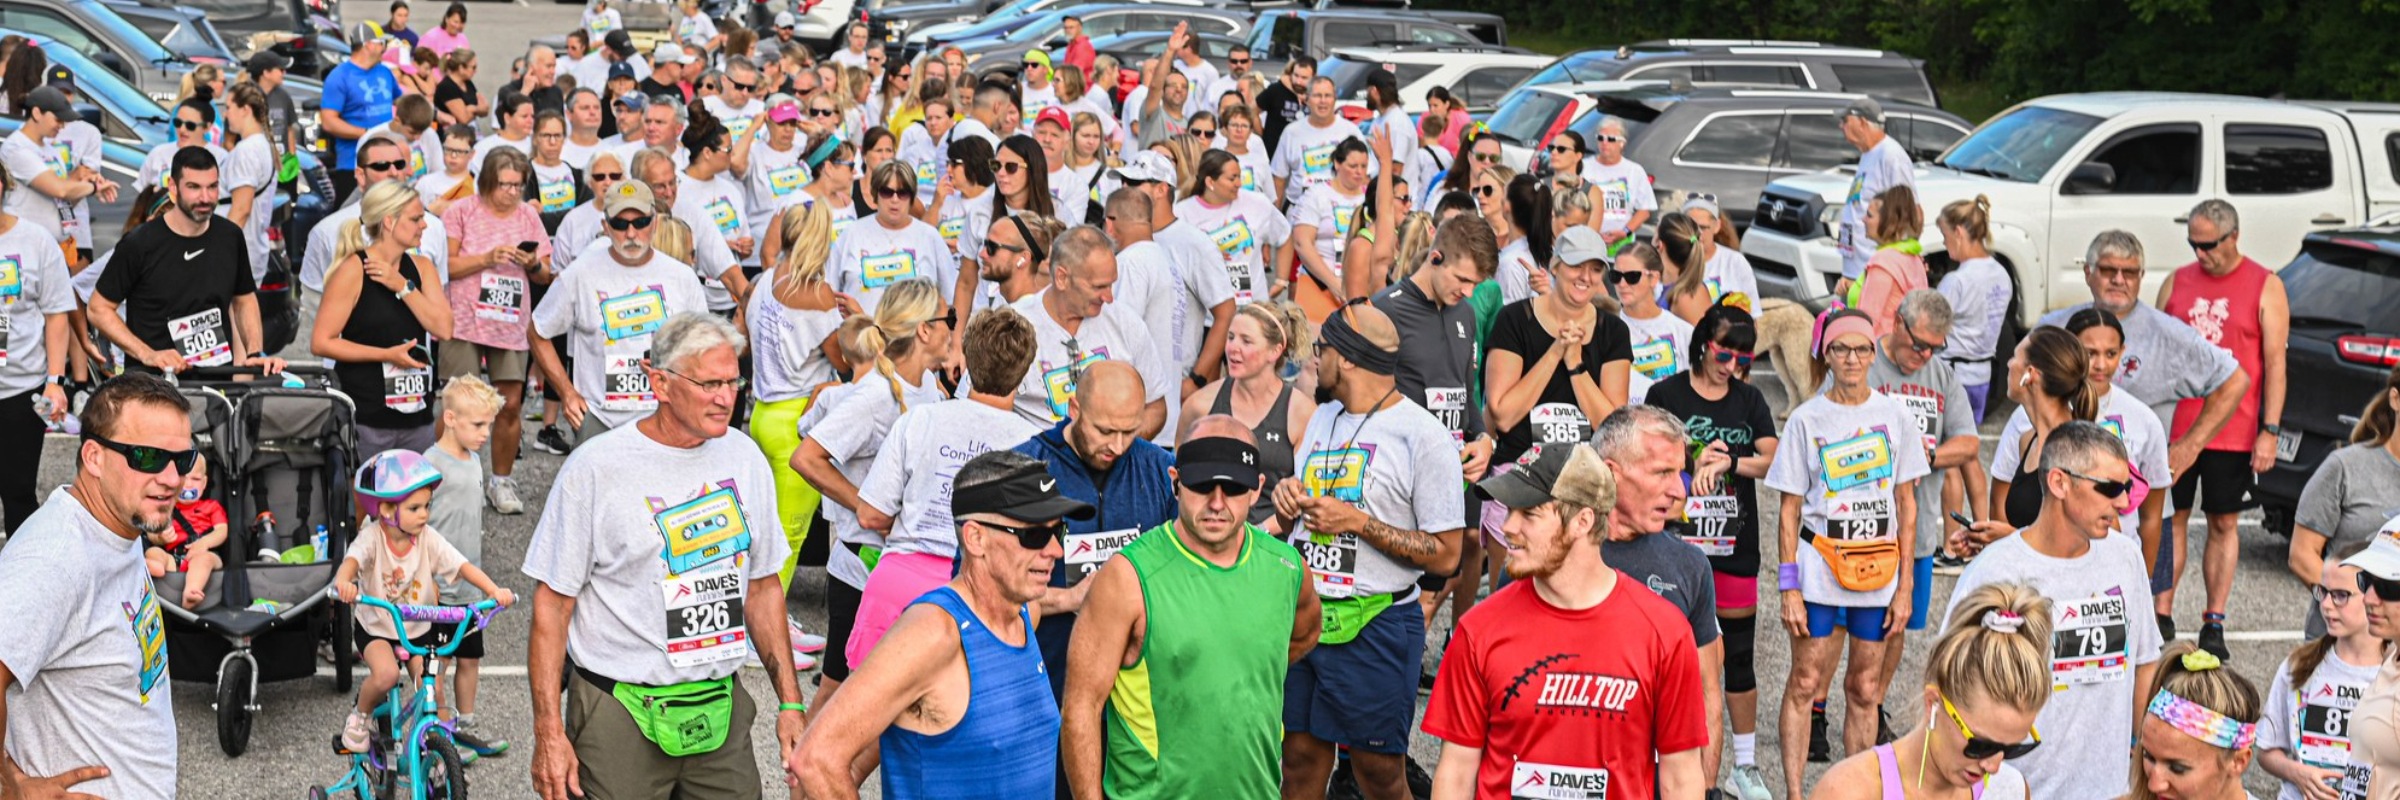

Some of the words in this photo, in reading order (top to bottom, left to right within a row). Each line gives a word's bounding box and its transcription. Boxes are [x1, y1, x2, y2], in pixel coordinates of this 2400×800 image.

[487, 290, 514, 308] 384
[183, 329, 217, 356] 509
[395, 375, 424, 395] 508
[616, 374, 651, 393] 360
[1543, 423, 1580, 443] 365
[1694, 517, 1728, 537] 107
[1839, 519, 1878, 540] 129
[1303, 542, 1342, 572] 368
[694, 573, 739, 593] DAVE'S
[2081, 600, 2122, 616] DAVE'S
[682, 601, 730, 637] 326
[2076, 627, 2107, 657] 79
[1538, 673, 1639, 711] HILLTOP
[2337, 685, 2365, 700] DAV
[1549, 771, 1605, 791] DAVE'S
